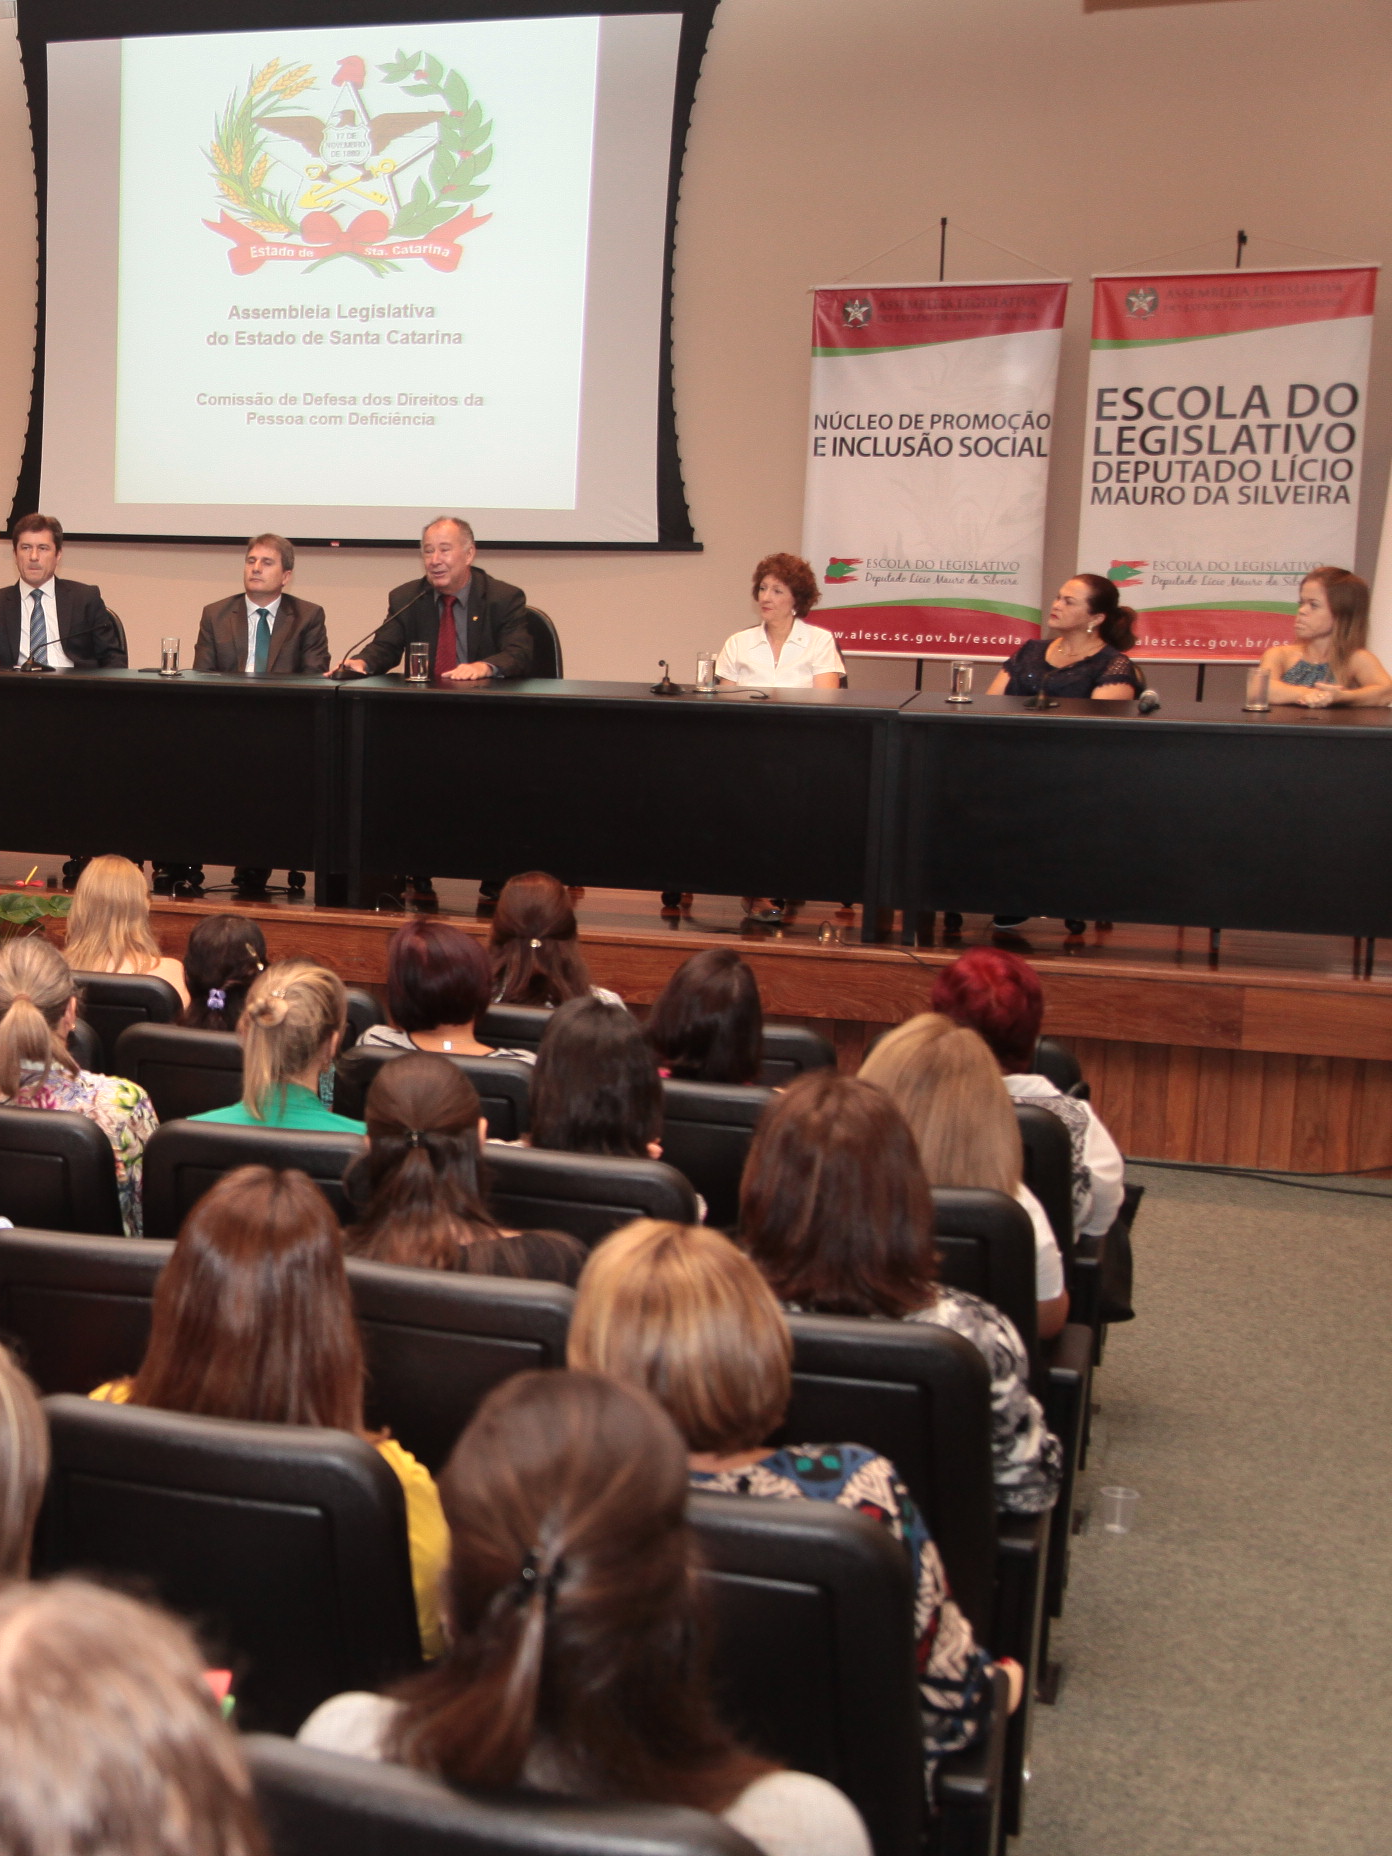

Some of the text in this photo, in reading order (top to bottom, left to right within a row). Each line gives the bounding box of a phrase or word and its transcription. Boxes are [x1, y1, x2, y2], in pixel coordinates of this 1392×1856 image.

[250, 246, 314, 258] Estado de
[363, 243, 450, 257] Sta. Catarina
[228, 304, 435, 323] Assembleia Legislativa
[206, 329, 463, 346] do Estado de Santa Catarina
[196, 392, 484, 406] Comissão de Defesa dos Direitos da
[1096, 382, 1359, 421] ESCOLA DO
[246, 412, 435, 426] Pessoa com Deficiência
[814, 411, 1051, 434] NÚCLEO DE PROMOÇÃO
[813, 433, 1048, 458] E INCLUSÃO SOCIAL
[1093, 422, 1356, 456] LEGISLATIVO
[1092, 454, 1353, 484] DEPUTADO LÍCIO
[1090, 484, 1351, 505] MAURO DA SILVEIRA
[866, 559, 1020, 571] ESCOLA DO LEGISLATIVO
[1152, 561, 1203, 572] ESCOLA
[1208, 561, 1230, 572] DO
[865, 572, 907, 587] Deputado
[934, 574, 965, 584] Mauro
[981, 574, 1019, 585] Silveira
[1151, 574, 1198, 591] Deputado
[834, 629, 1022, 645] w.alesc.sc.gov.br/escola
